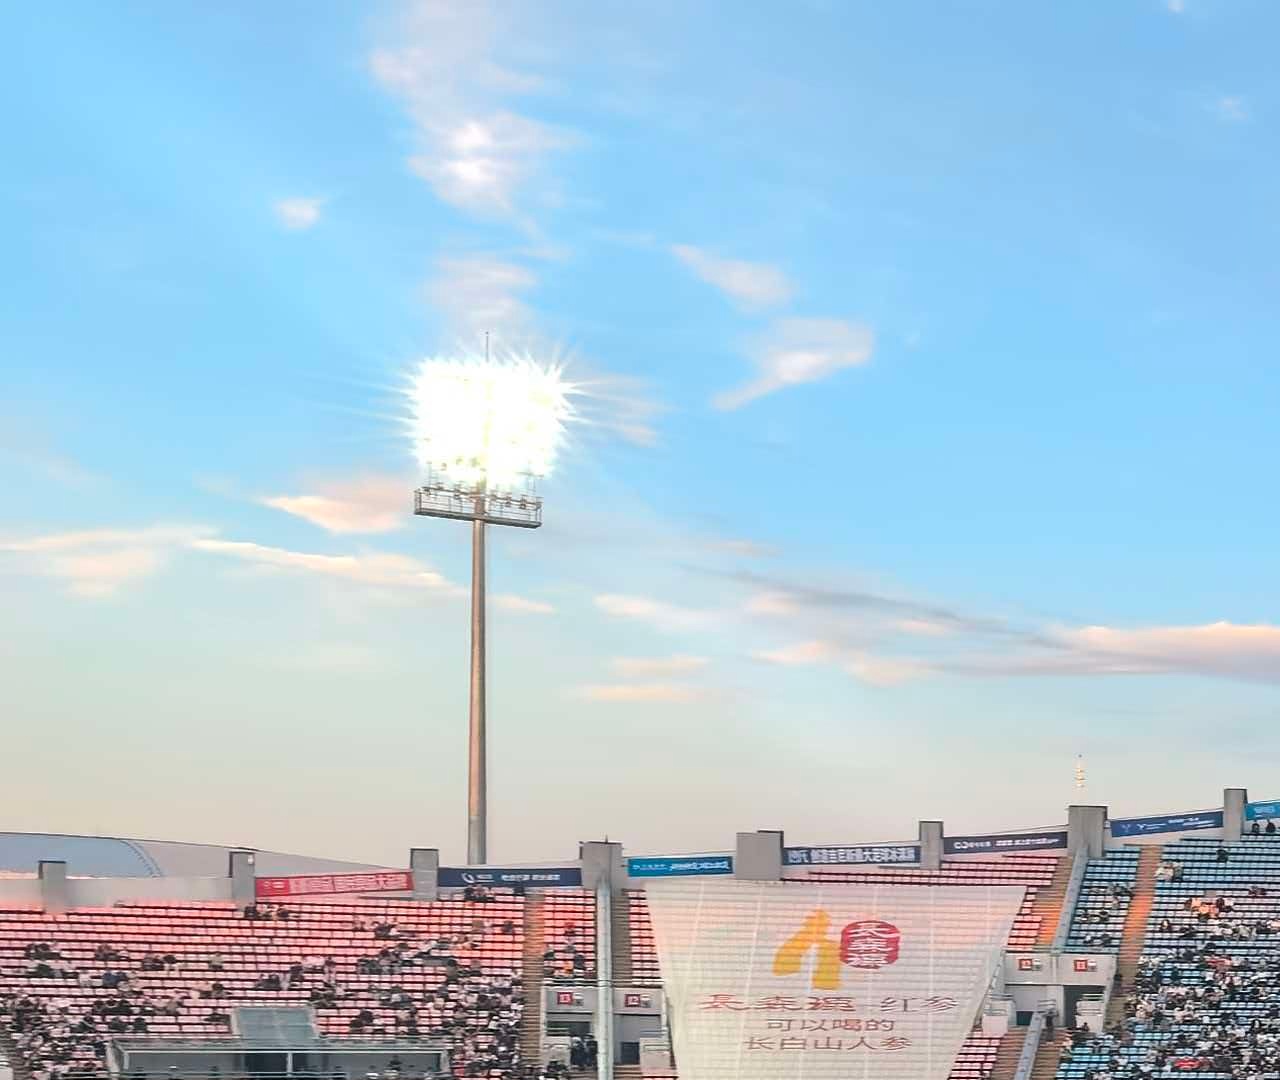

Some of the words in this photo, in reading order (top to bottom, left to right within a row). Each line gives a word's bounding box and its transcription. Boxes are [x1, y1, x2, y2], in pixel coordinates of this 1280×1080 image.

[881, 996, 960, 1013] 红参
[767, 1018, 896, 1033] 可以喝的
[744, 1036, 914, 1051] 长白山人参
